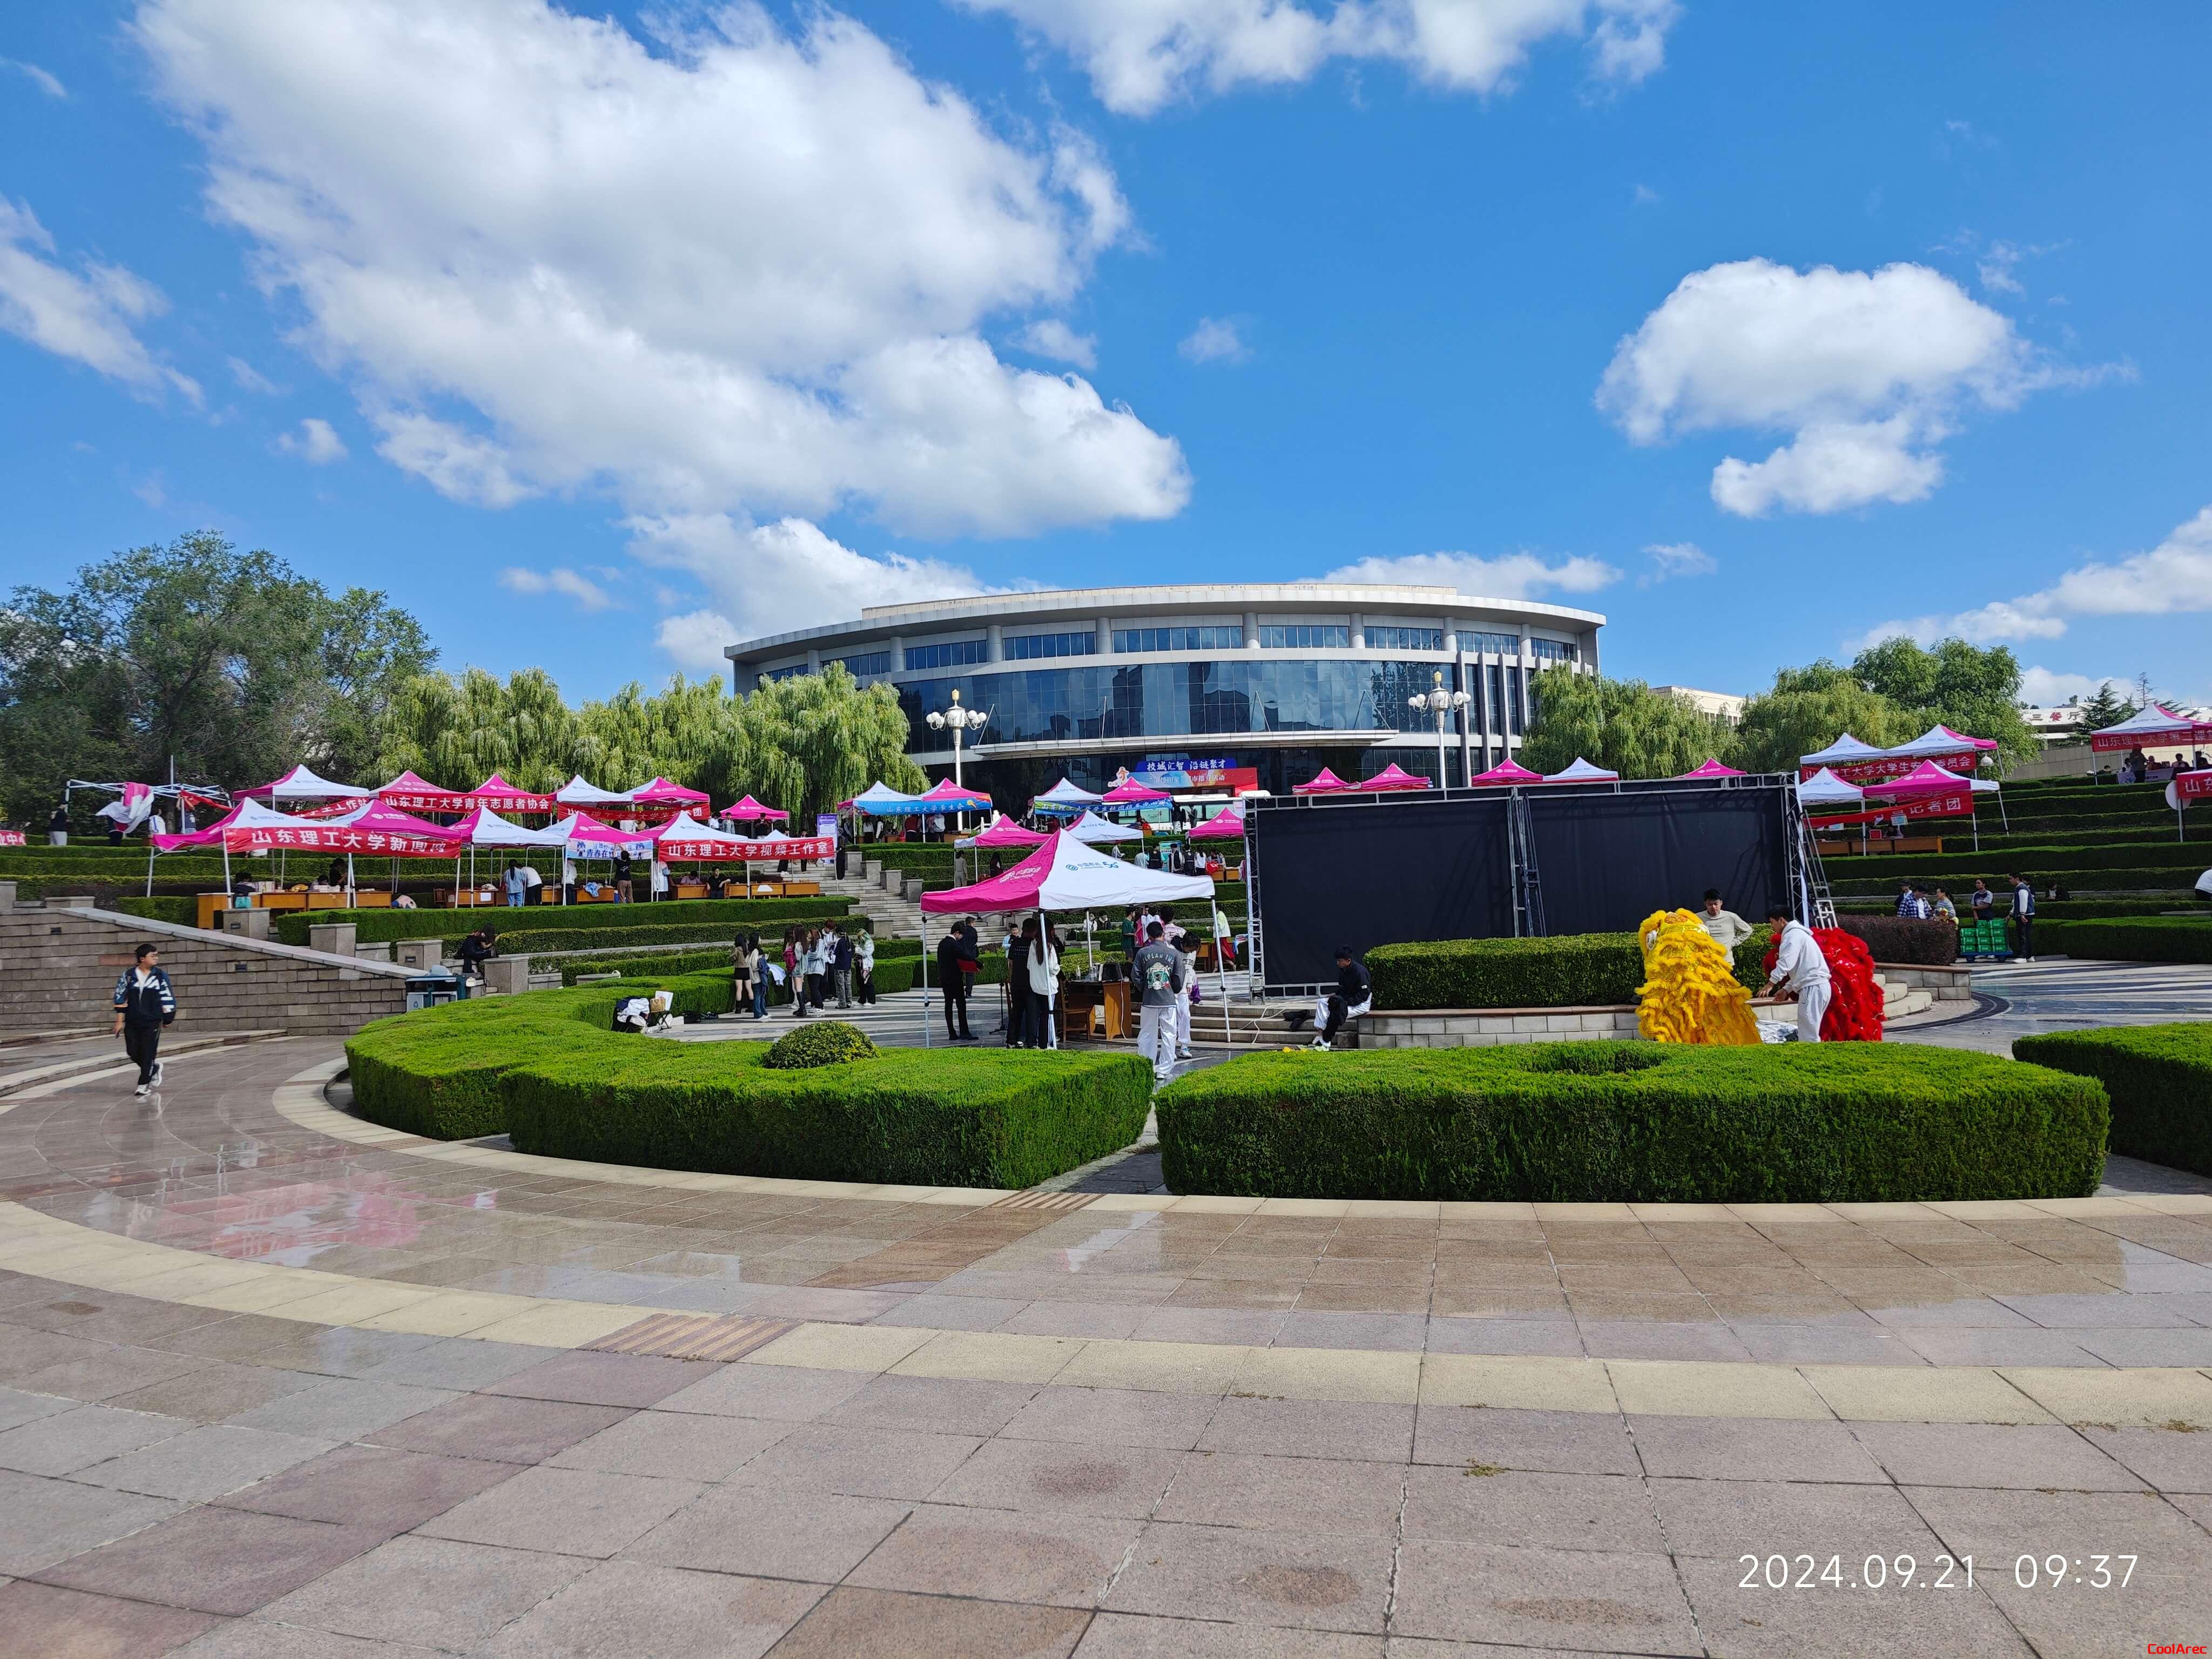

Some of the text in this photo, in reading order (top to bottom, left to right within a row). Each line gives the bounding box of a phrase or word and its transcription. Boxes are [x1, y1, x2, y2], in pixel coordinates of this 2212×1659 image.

[1147, 759, 1226, 772] 校城汇智 沿链聚才
[1805, 756, 1971, 780] 山理工大学大学生安委员会
[385, 796, 549, 810] 山东理工大学青年志愿者协会
[886, 804, 965, 813] 山东理工大学学生会
[668, 841, 828, 857] 山东理工大学视频工作室
